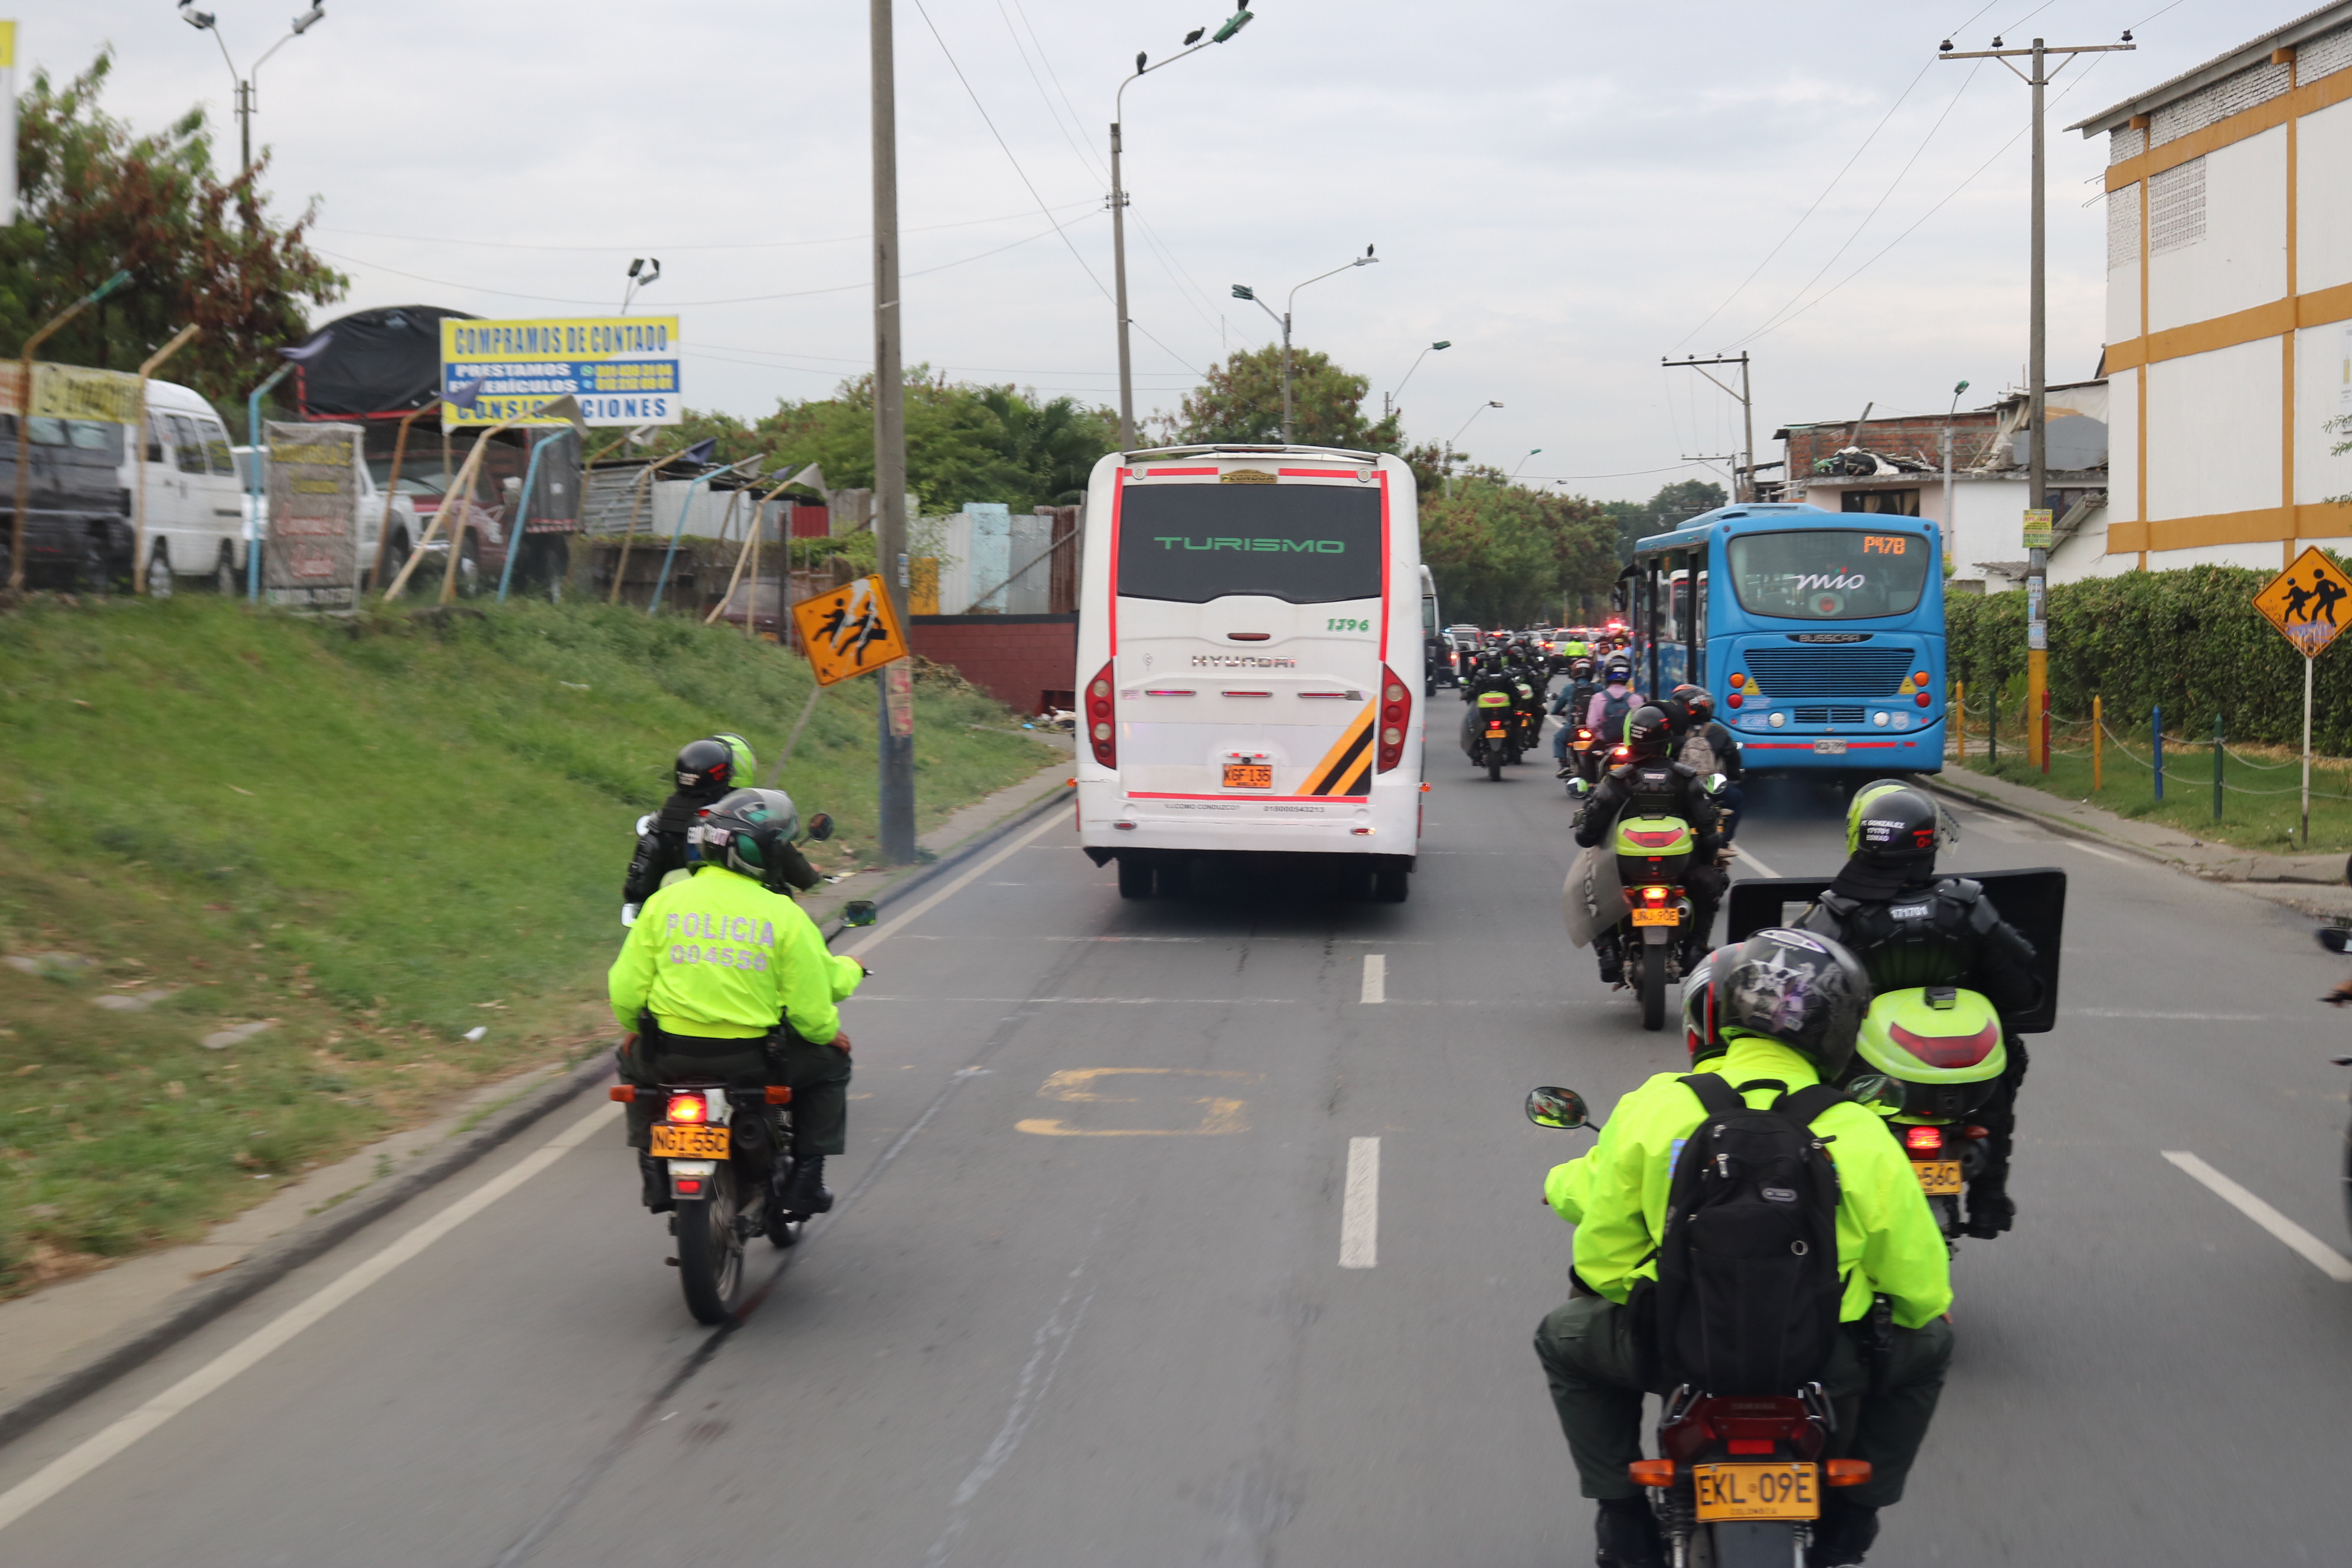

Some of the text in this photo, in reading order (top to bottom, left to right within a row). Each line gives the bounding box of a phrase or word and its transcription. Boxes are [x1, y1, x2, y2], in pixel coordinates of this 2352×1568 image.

[455, 325, 667, 355] COMPRAMOS DE CONTADO
[455, 363, 571, 378] PRESTAMOS
[479, 378, 579, 394] EHÍCULOS
[1154, 537, 1345, 553] TURISMO
[1785, 568, 1866, 590] mio
[1326, 618, 1370, 632] 1396
[1868, 819, 1906, 829] GONZALEZ
[1891, 905, 1928, 918] 171701
[666, 913, 775, 948] POLICIA
[669, 945, 768, 972] 004556
